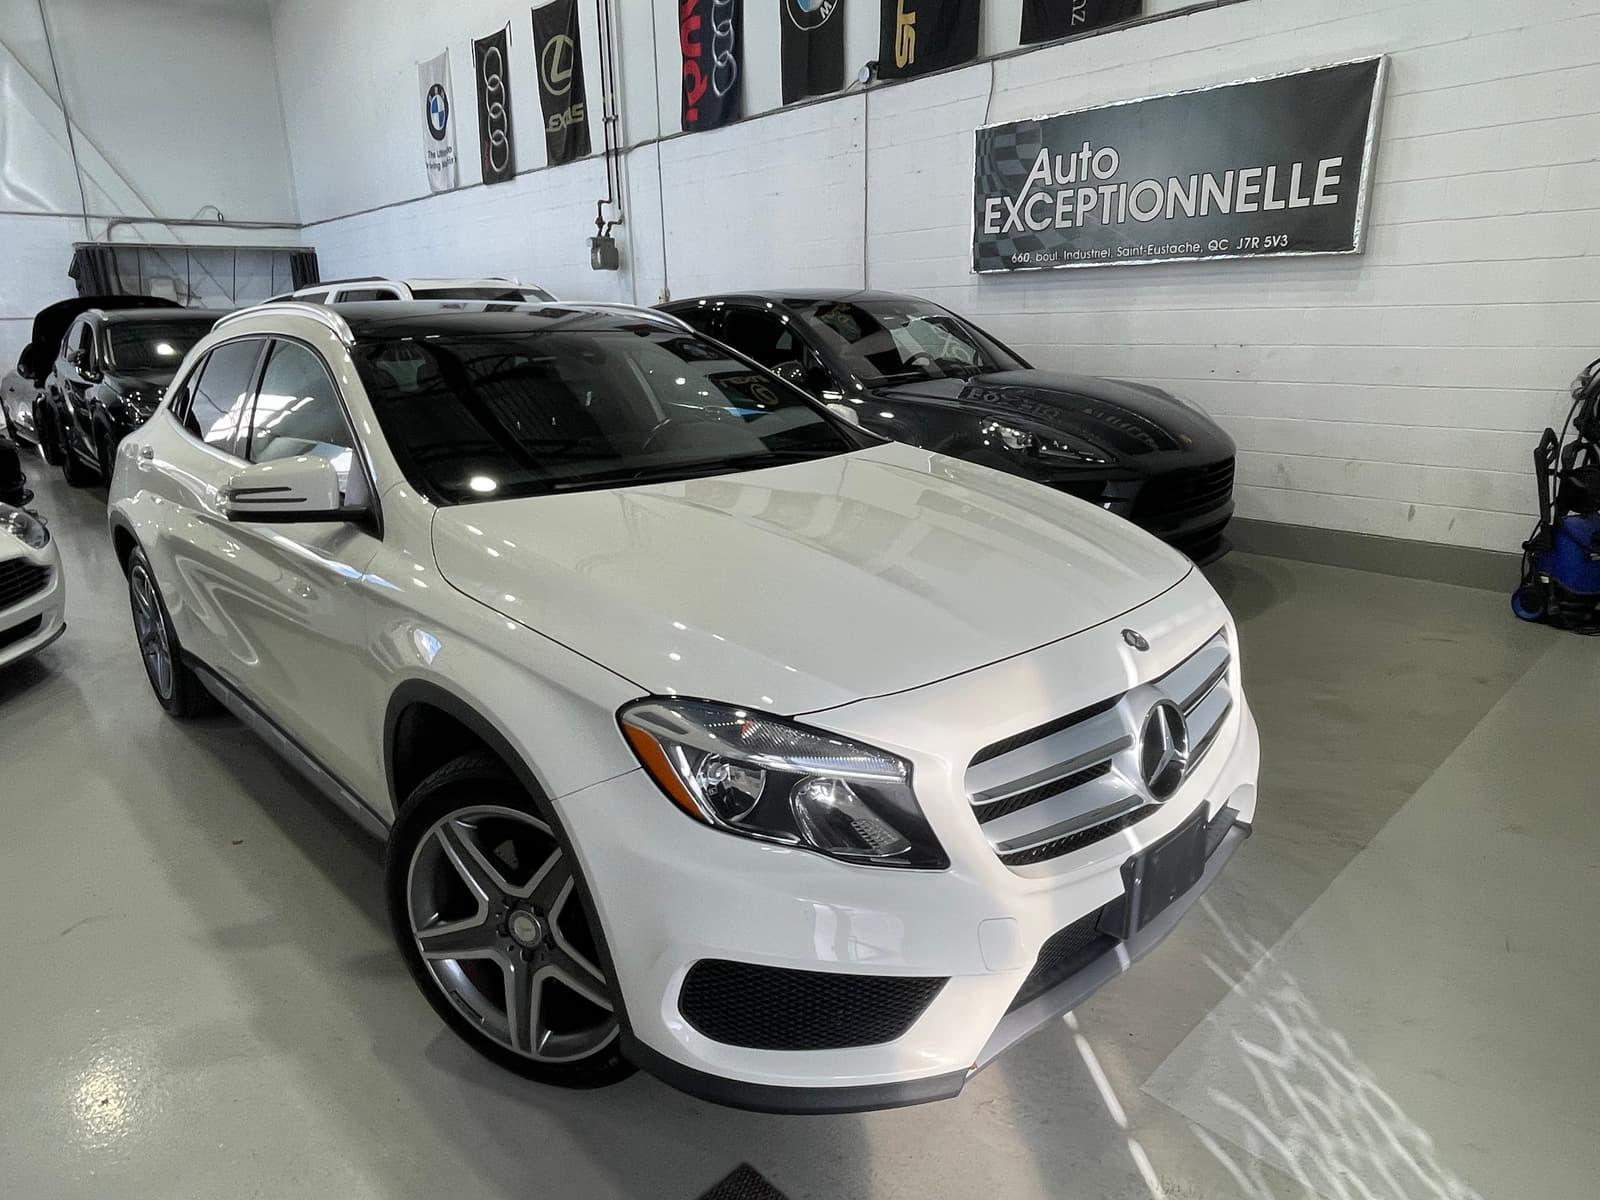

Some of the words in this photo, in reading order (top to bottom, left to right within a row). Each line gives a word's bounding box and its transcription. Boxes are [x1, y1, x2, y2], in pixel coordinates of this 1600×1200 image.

[1020, 141, 1120, 194] Auto
[983, 156, 1343, 235] EXCEPTIONNELLE
[1011, 252, 1033, 264] 660,
[1117, 242, 1203, 257] Saint-Eustache,
[1207, 239, 1229, 251] QC
[1236, 236, 1260, 250] J7R
[1263, 234, 1289, 248] 5V3
